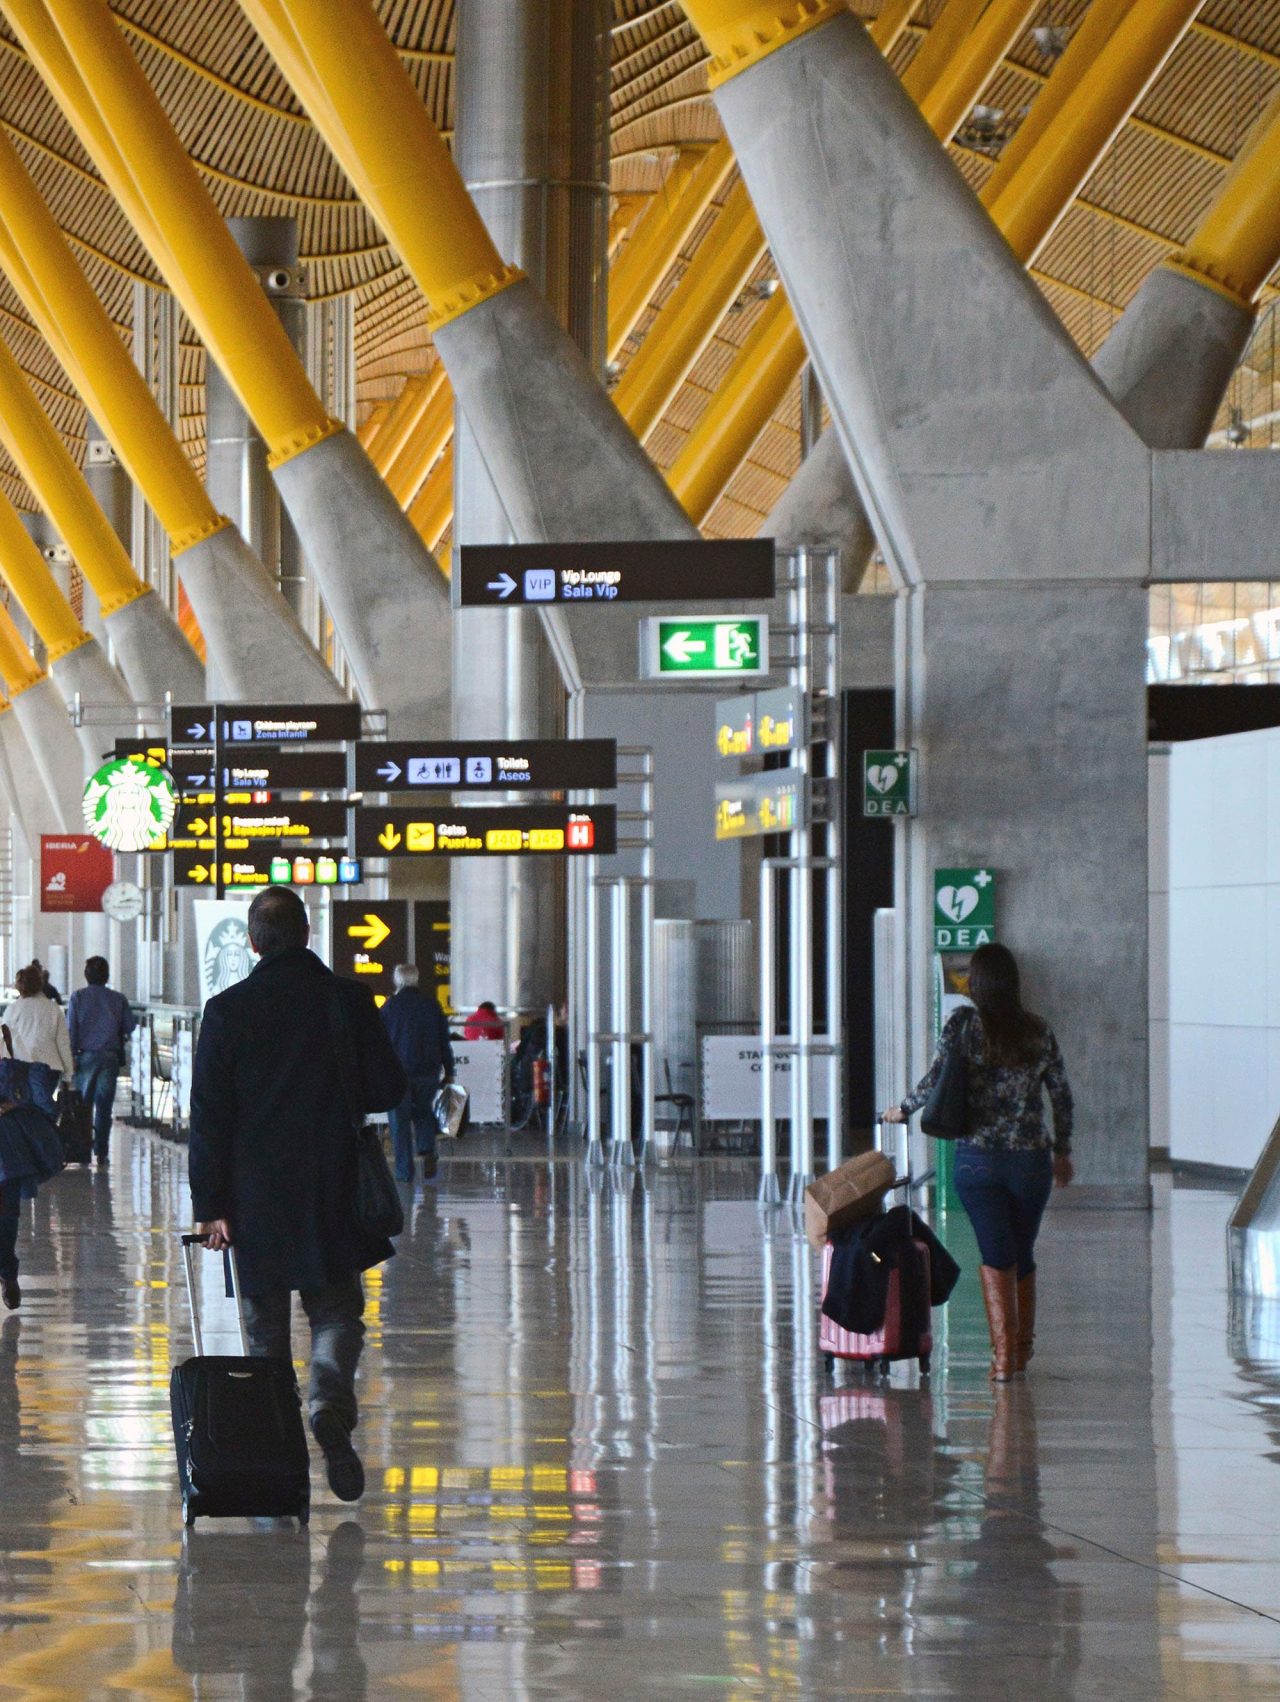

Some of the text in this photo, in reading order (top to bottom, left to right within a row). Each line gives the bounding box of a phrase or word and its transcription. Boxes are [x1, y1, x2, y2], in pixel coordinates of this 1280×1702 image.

[530, 569, 621, 591] VIP Vip Lounge
[563, 583, 618, 599] Sala Vip
[256, 729, 308, 739] Zona Infantil
[496, 757, 529, 770] Toilets
[498, 770, 531, 781] Aseos
[233, 778, 267, 788] Sala Vip
[867, 801, 908, 814] DEA
[438, 836, 483, 849] Puertas
[571, 825, 589, 846] H
[937, 930, 991, 946] DEA
